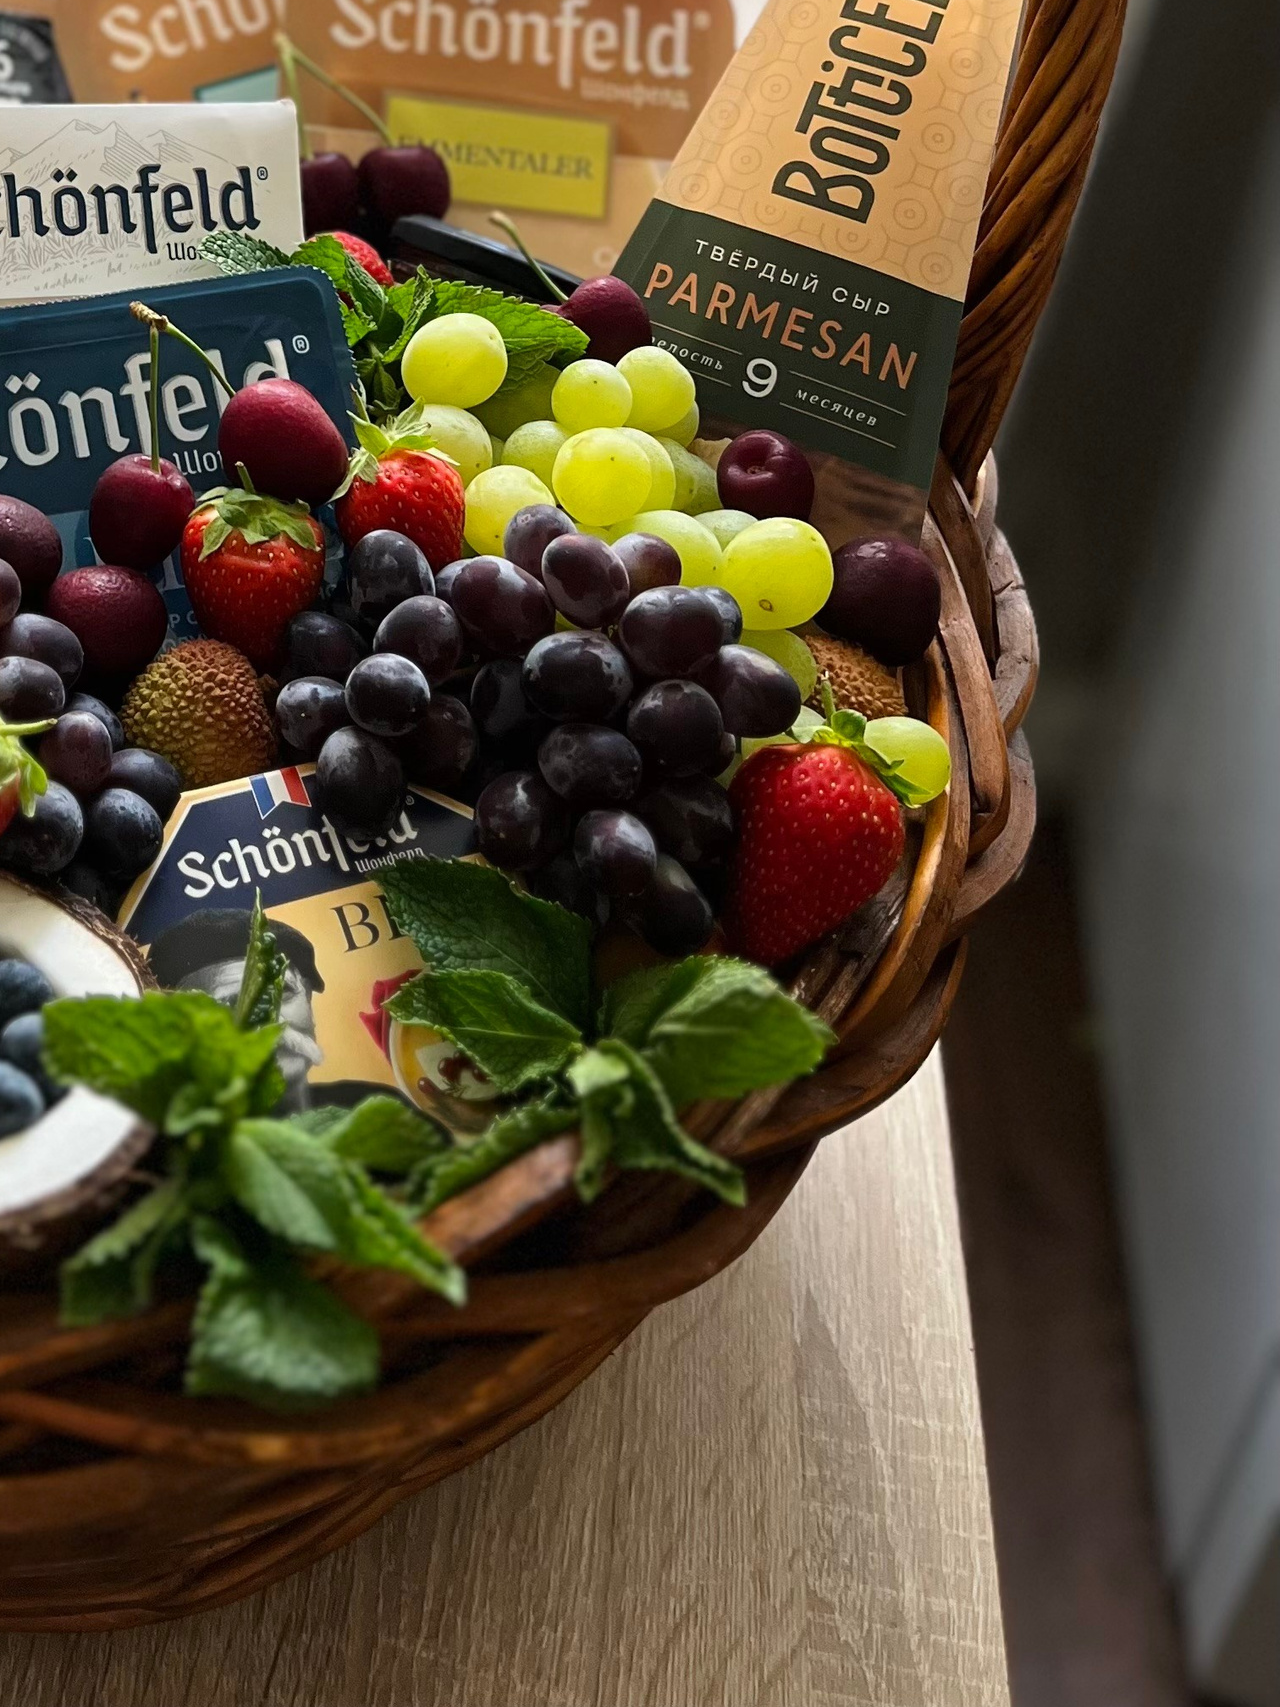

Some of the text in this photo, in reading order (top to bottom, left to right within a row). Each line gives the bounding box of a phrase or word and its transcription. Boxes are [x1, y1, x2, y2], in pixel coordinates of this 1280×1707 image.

[695, 239, 891, 317] ТВЁРДЫЙ СЫР
[643, 262, 918, 390] PARMESAN
[742, 358, 778, 398] 9
[795, 388, 878, 427] месяцев
